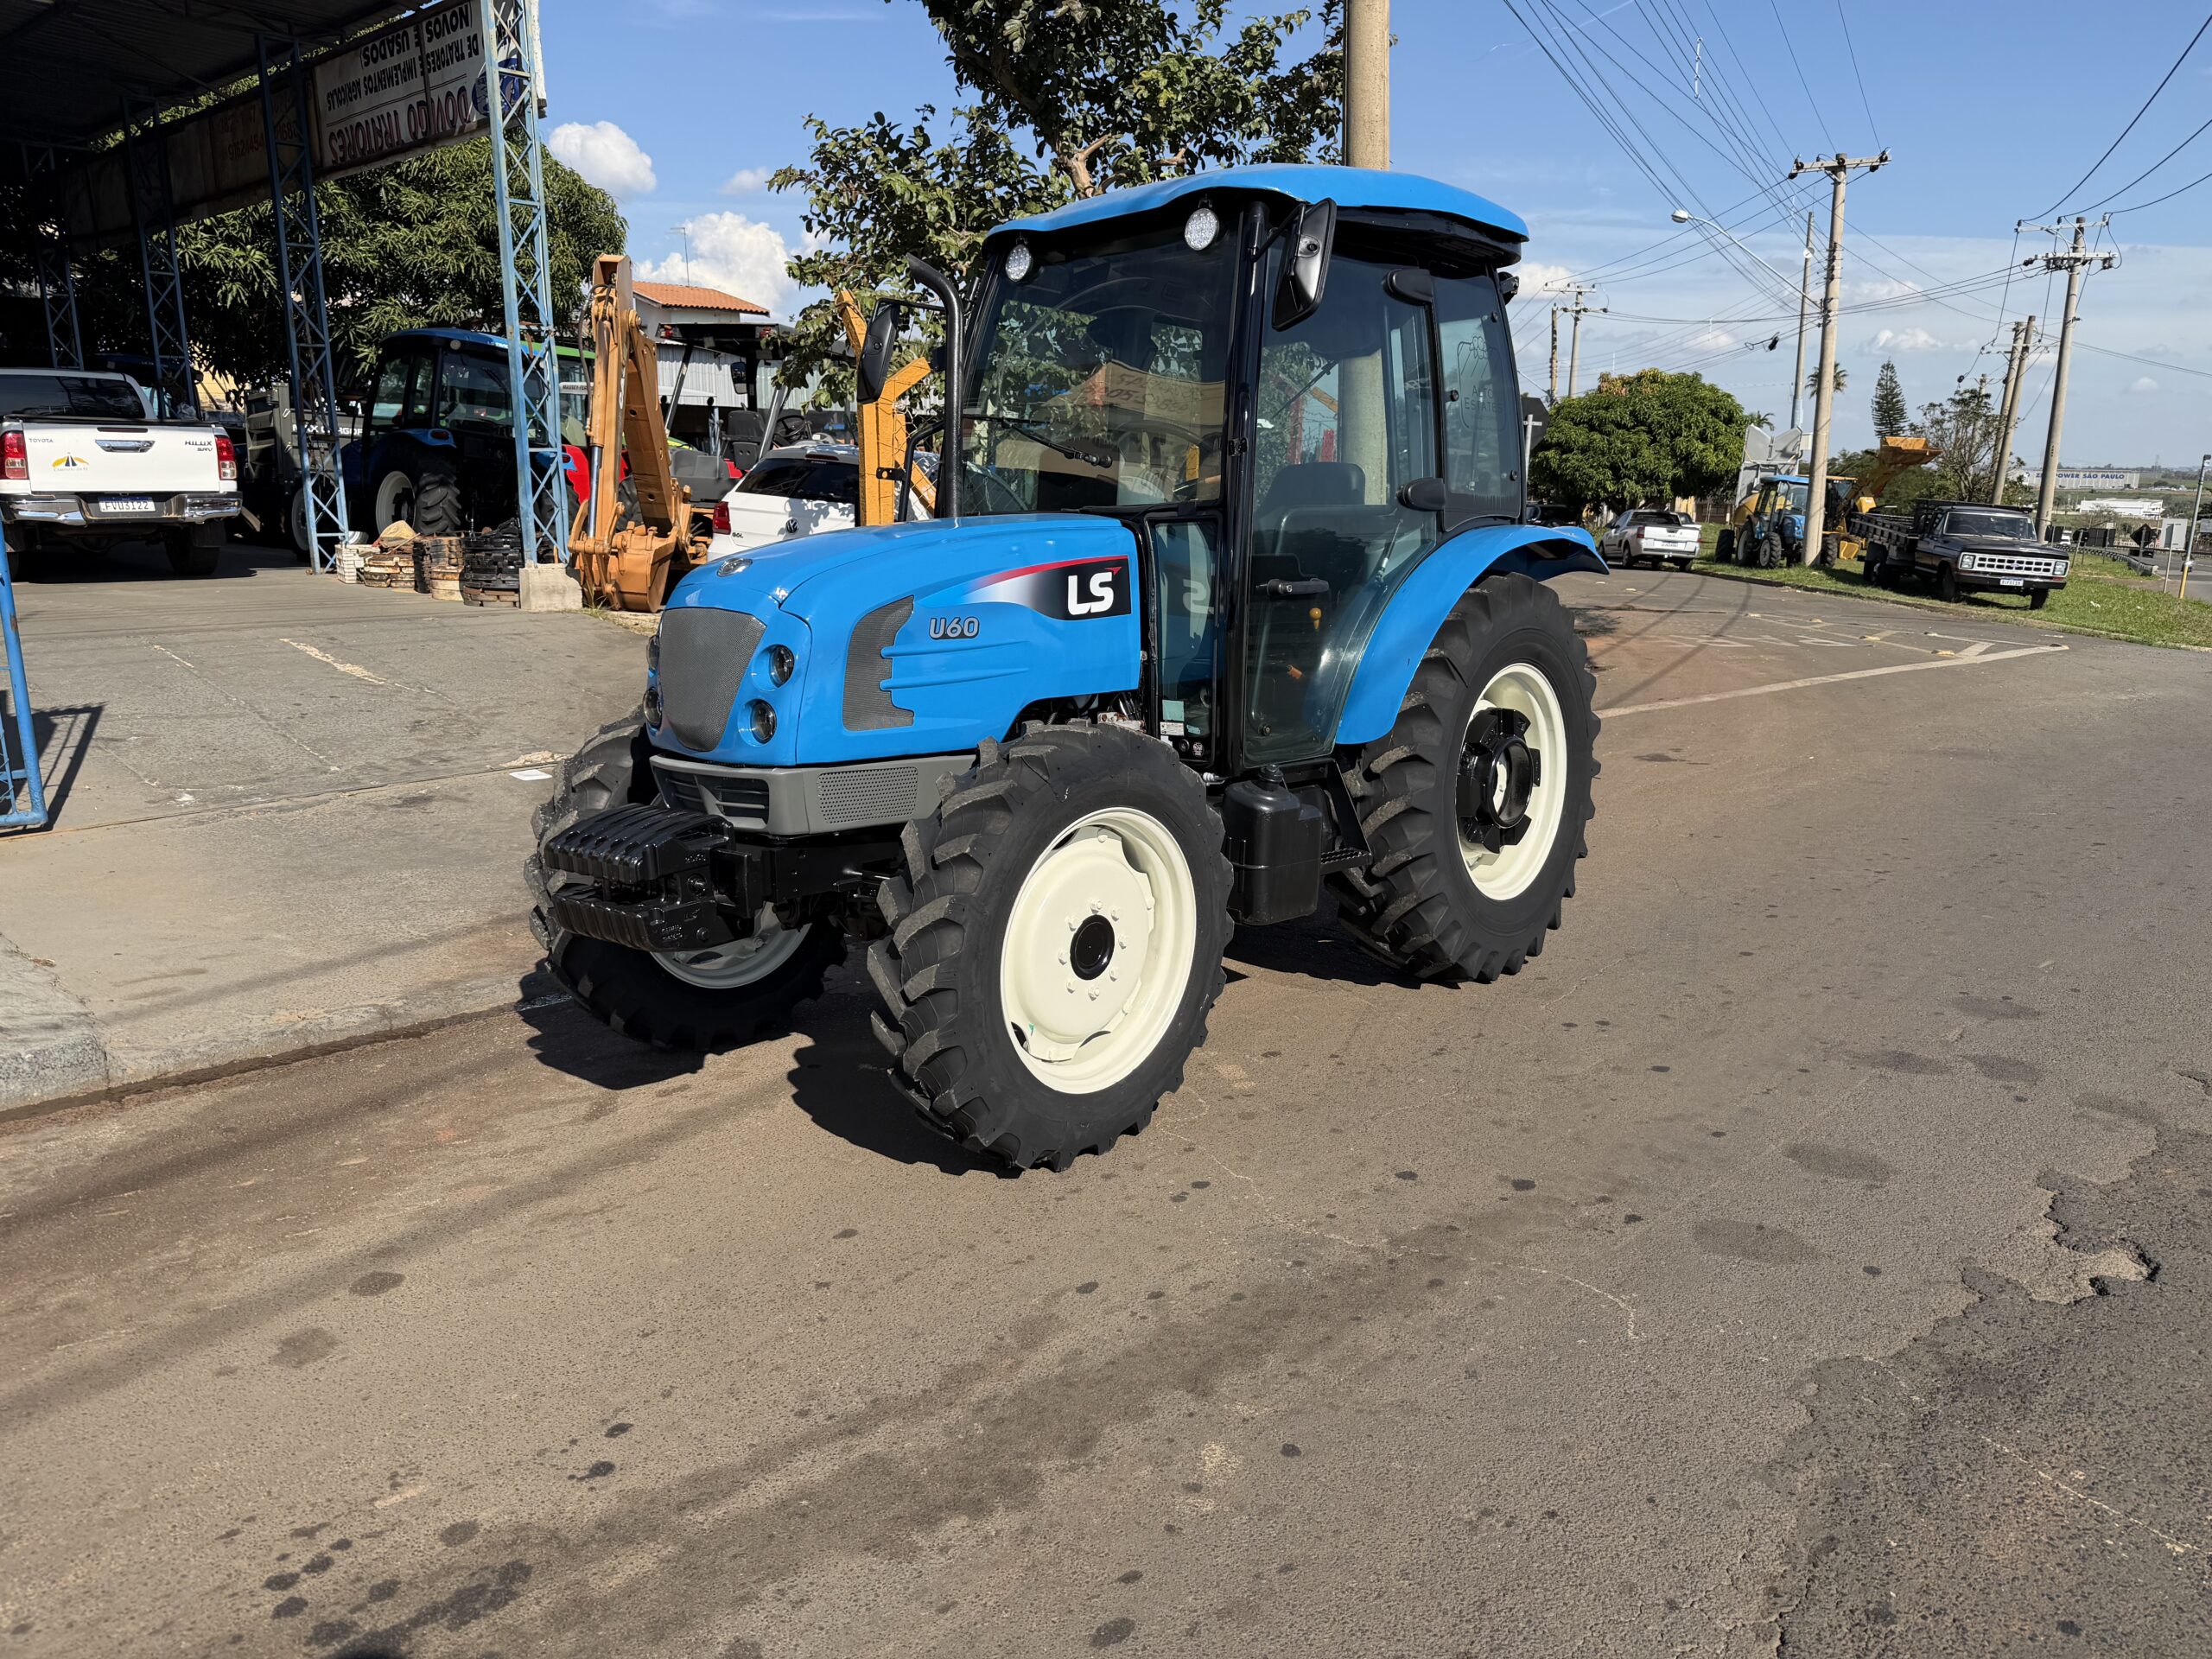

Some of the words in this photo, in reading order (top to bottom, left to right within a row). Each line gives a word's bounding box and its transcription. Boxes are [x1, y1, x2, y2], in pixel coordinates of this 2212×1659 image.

[426, 36, 467, 75] TRATORES
[467, 32, 480, 59] DE
[363, 57, 417, 96] IMPLEMENTOS
[328, 109, 401, 165] TRATORES
[1067, 571, 1115, 616] LS
[929, 616, 981, 640] U60
